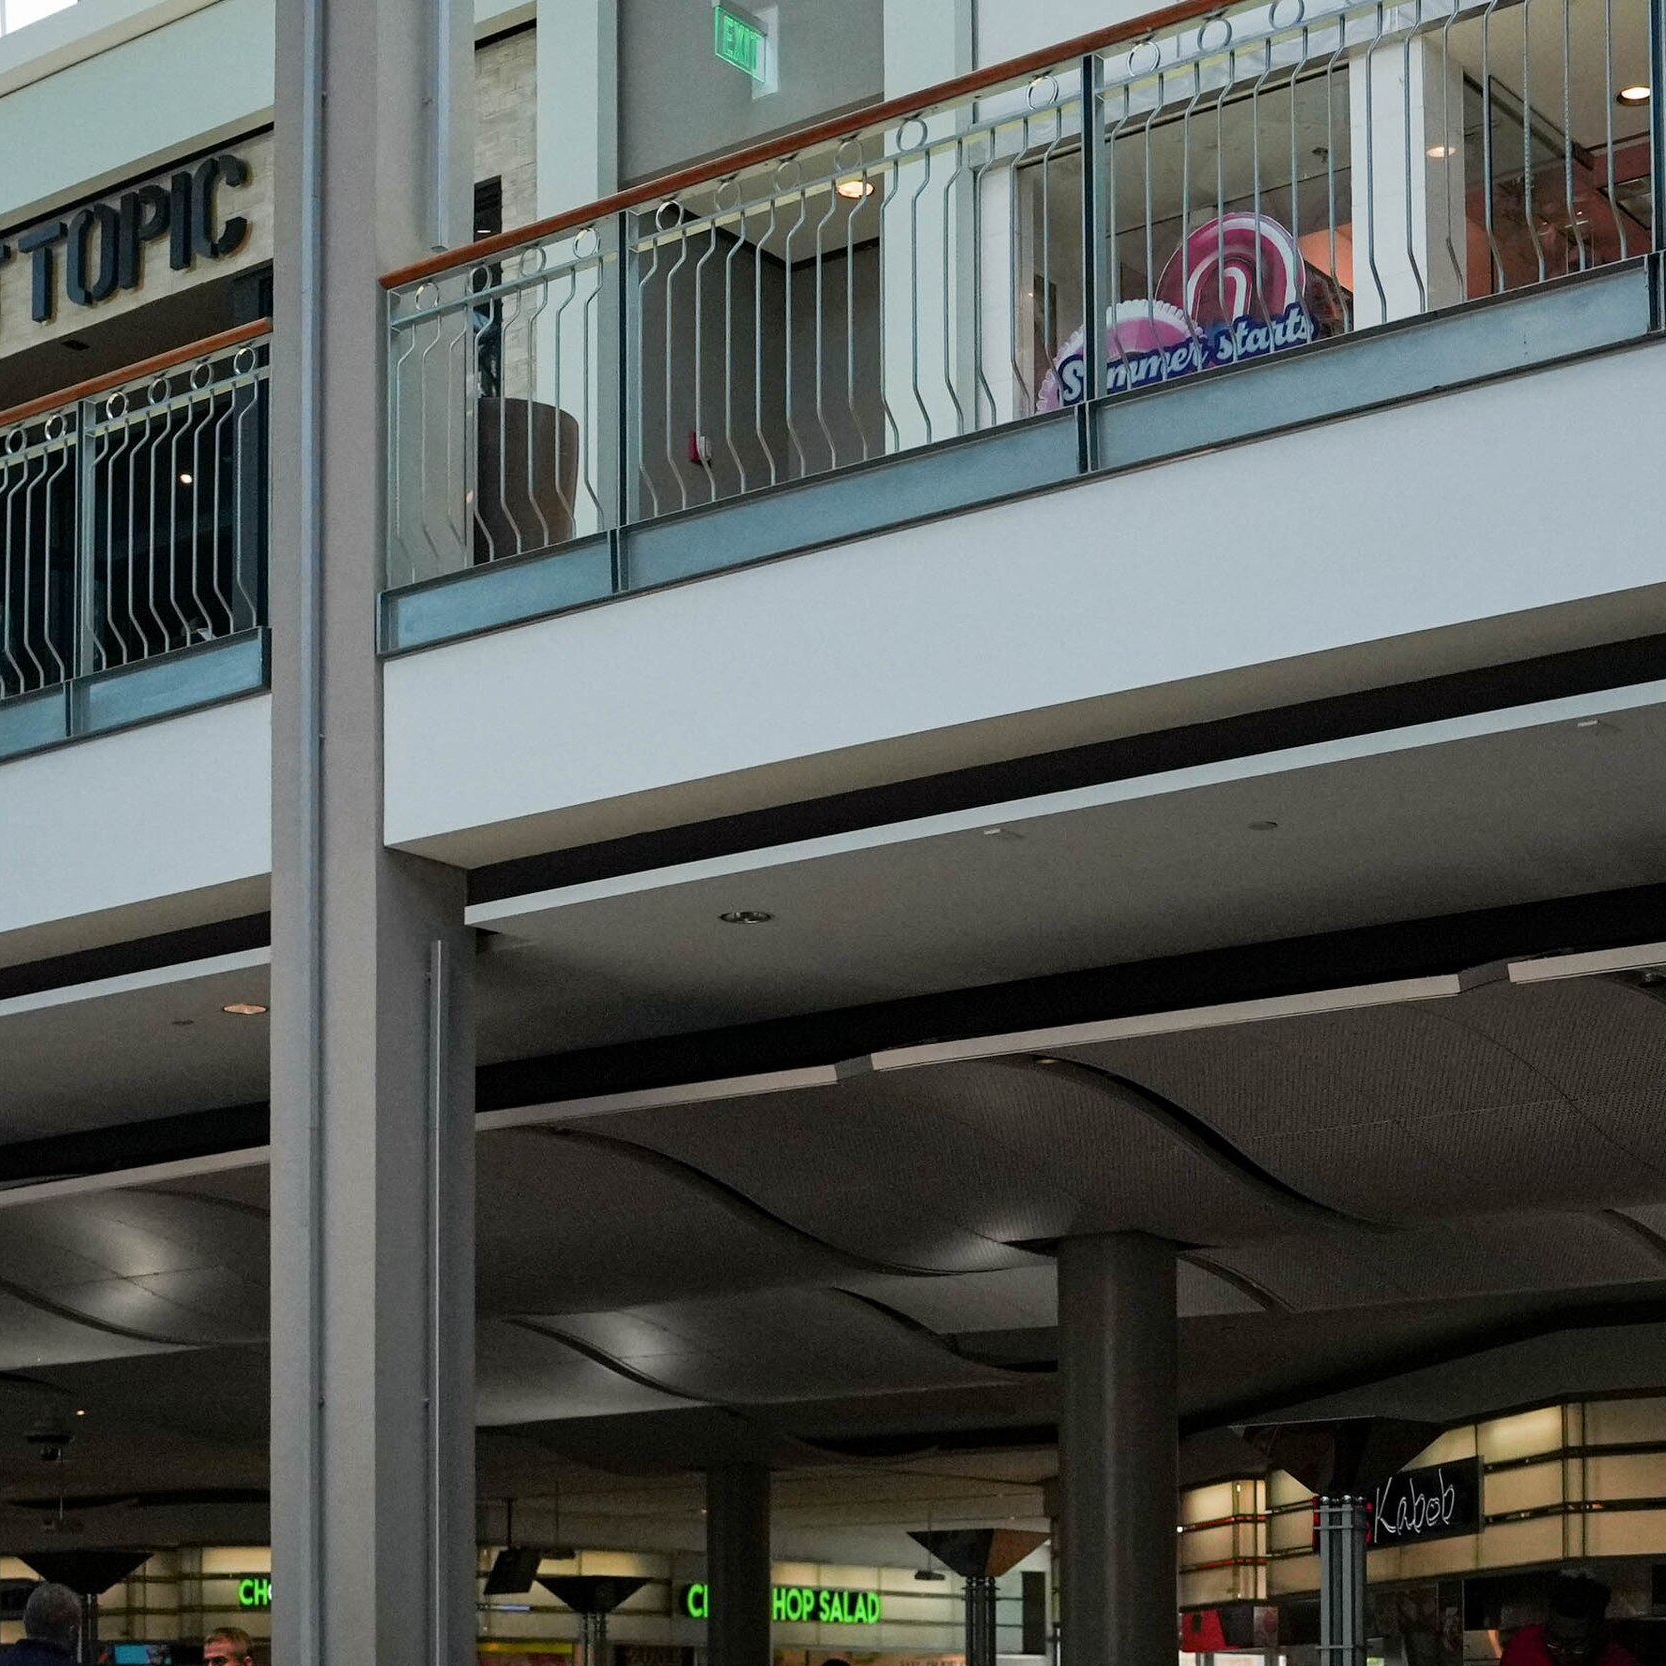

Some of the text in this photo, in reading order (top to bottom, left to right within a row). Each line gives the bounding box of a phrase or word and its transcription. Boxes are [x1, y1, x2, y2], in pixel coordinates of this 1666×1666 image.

[723, 15, 762, 71] EXIT
[18, 154, 250, 323] TOPIC
[1062, 342, 1209, 401] Smmer
[1374, 1468, 1455, 1543] Kabob
[771, 1587, 882, 1624] HOP SALAD
